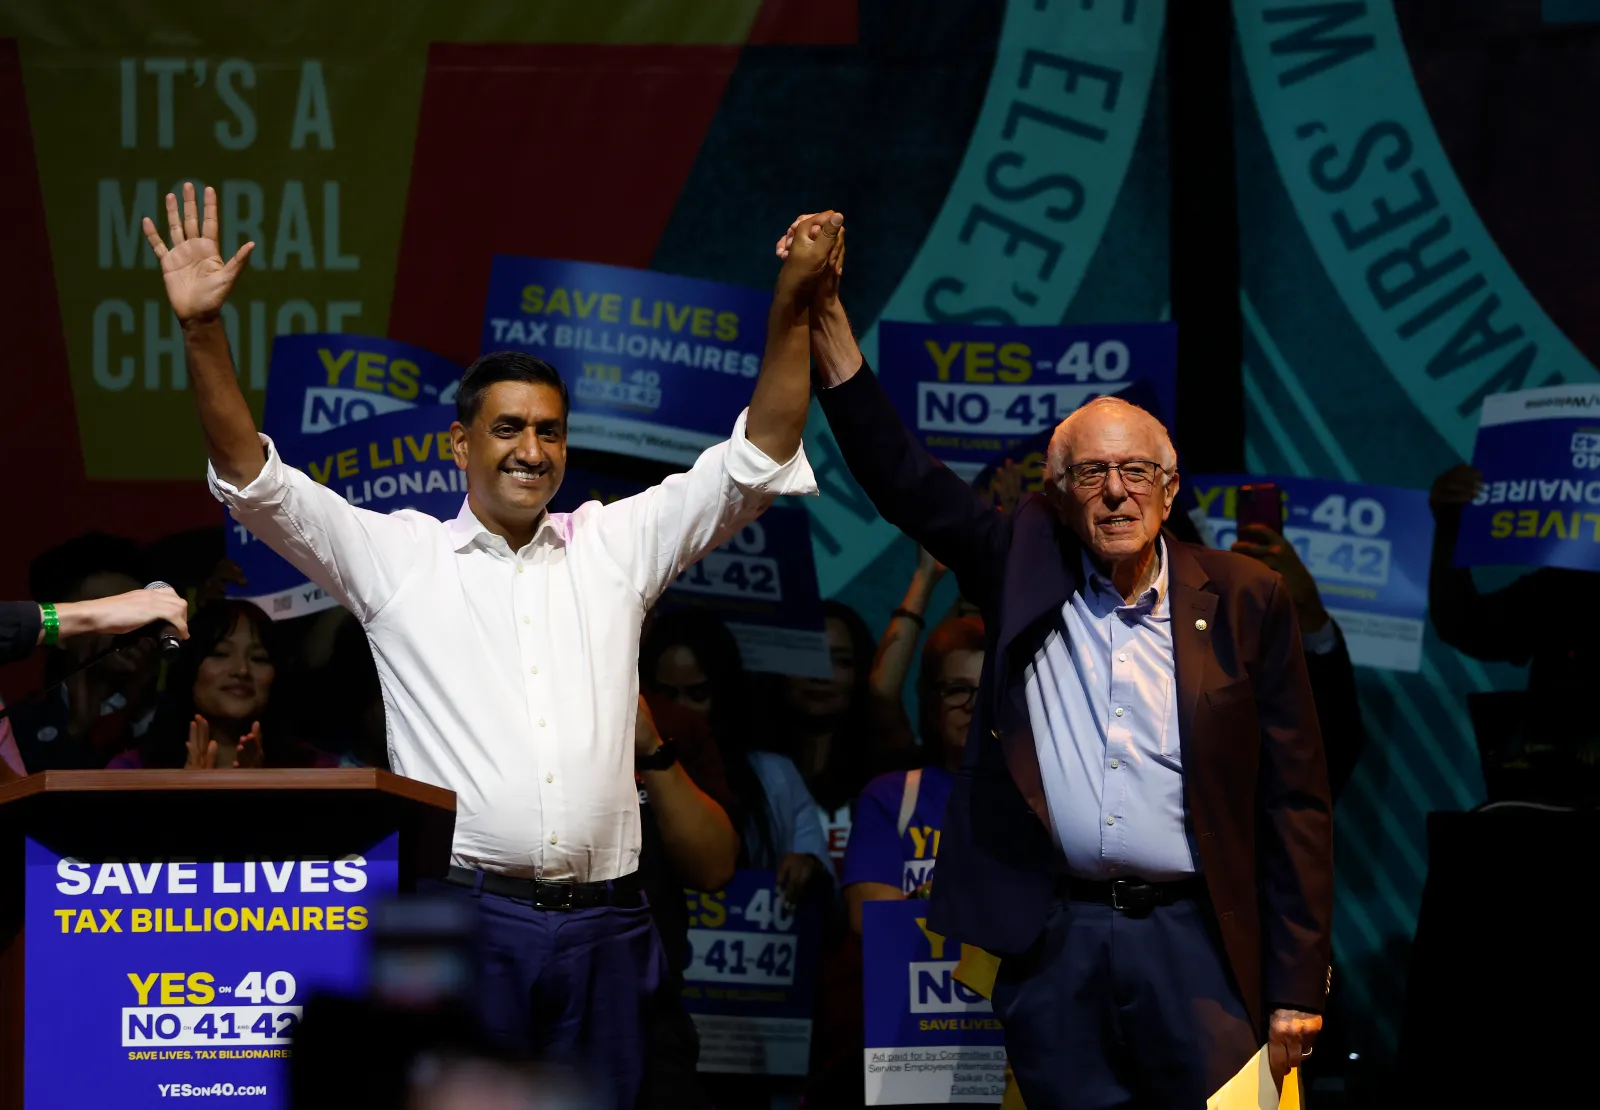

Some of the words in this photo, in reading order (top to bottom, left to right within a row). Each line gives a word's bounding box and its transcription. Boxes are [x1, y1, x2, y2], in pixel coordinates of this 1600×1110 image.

[119, 57, 258, 151] IT'S
[290, 59, 336, 150] A
[520, 284, 621, 323] SAVE
[629, 301, 740, 342] LIVES
[489, 317, 548, 347] TAX
[553, 324, 761, 379] BILLIONAIRES
[924, 340, 1033, 383] YES
[1055, 339, 1131, 382] 40
[317, 348, 422, 400] YES
[925, 391, 990, 424] NO
[296, 448, 360, 486] VE
[369, 431, 453, 470] LIVE
[1472, 478, 1600, 507] ONAIRES
[1311, 493, 1386, 537] 40
[723, 561, 776, 593] 42
[1328, 541, 1385, 578] 42
[56, 856, 198, 895] SAVE
[212, 855, 368, 894] LIVES
[54, 908, 123, 933] TAX
[131, 906, 369, 932] BILLIONAIRES
[705, 940, 747, 975] 41
[756, 942, 792, 977] 42
[127, 972, 216, 1005] YES
[218, 985, 232, 994] ON
[234, 970, 297, 1004] 40
[128, 1013, 182, 1039] NO
[193, 1013, 241, 1039] 41
[251, 1012, 299, 1039] 42
[919, 1019, 958, 1031] SAVE
[128, 1051, 158, 1061] SAVE
[159, 1050, 194, 1060] LIVES.
[195, 1050, 217, 1060] TAX
[868, 1064, 902, 1073] Service
[872, 1052, 885, 1062] Ad
[888, 1051, 908, 1063] paid
[911, 1051, 922, 1061] for
[926, 1051, 936, 1062] by
[940, 1050, 991, 1061] Committee
[951, 1085, 989, 1096] Funding
